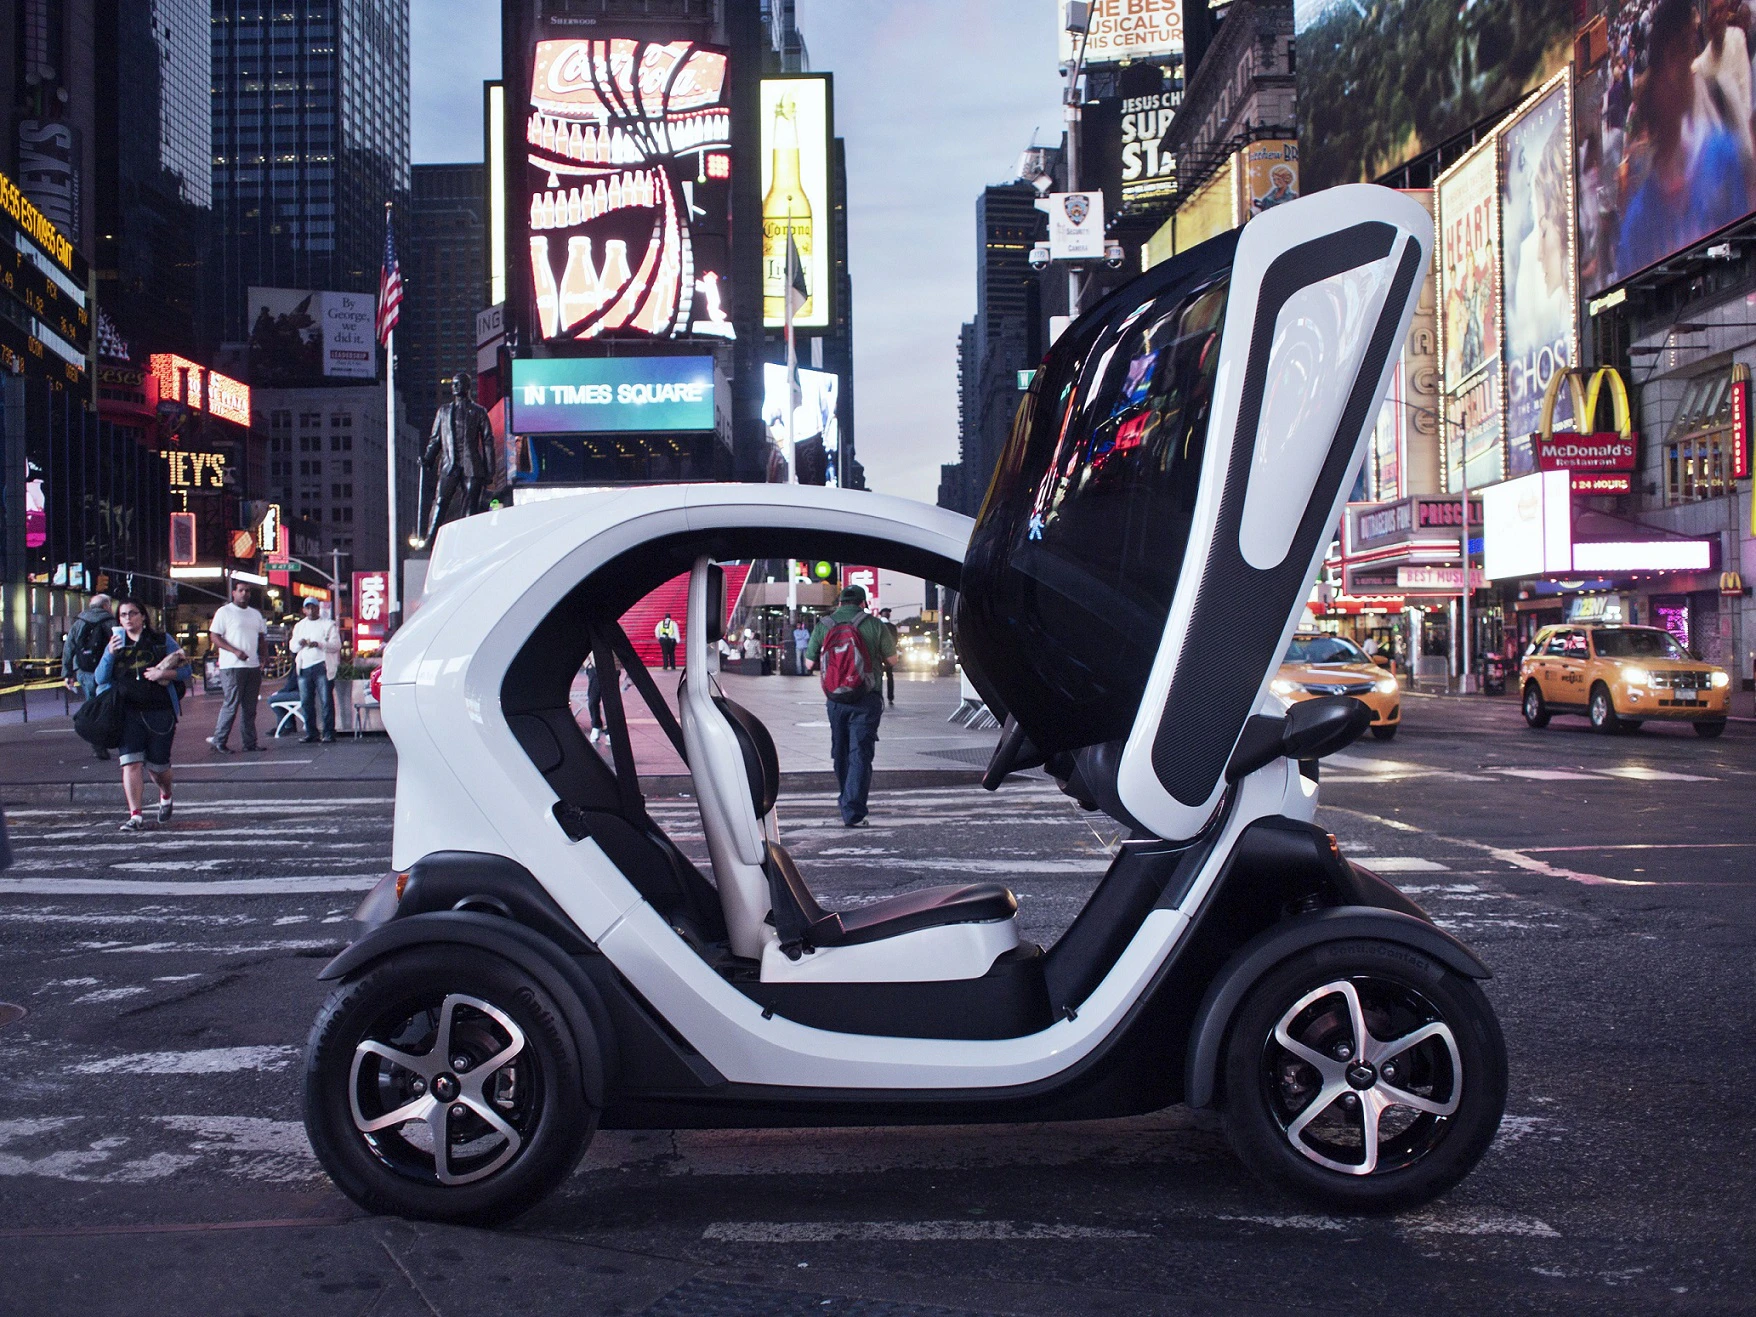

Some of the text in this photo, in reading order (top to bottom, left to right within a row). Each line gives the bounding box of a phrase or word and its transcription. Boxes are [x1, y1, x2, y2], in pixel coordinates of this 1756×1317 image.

[1089, 15, 1160, 35] USICAL
[1121, 94, 1160, 114] JESUS
[763, 221, 811, 239] Corona
[1446, 195, 1492, 271] HEART
[56, 233, 73, 271] GMT
[342, 297, 356, 311] By
[327, 308, 371, 323] George,
[342, 323, 356, 331] we
[334, 332, 351, 343] did
[524, 382, 703, 406] IN TIMES SQUARE
[1542, 443, 1633, 457] McDonald's
[1420, 502, 1483, 526] PRISCLL
[1407, 569, 1432, 583] BEST
[1437, 570, 1483, 584] MUSIAL
[361, 575, 385, 620] tkts
